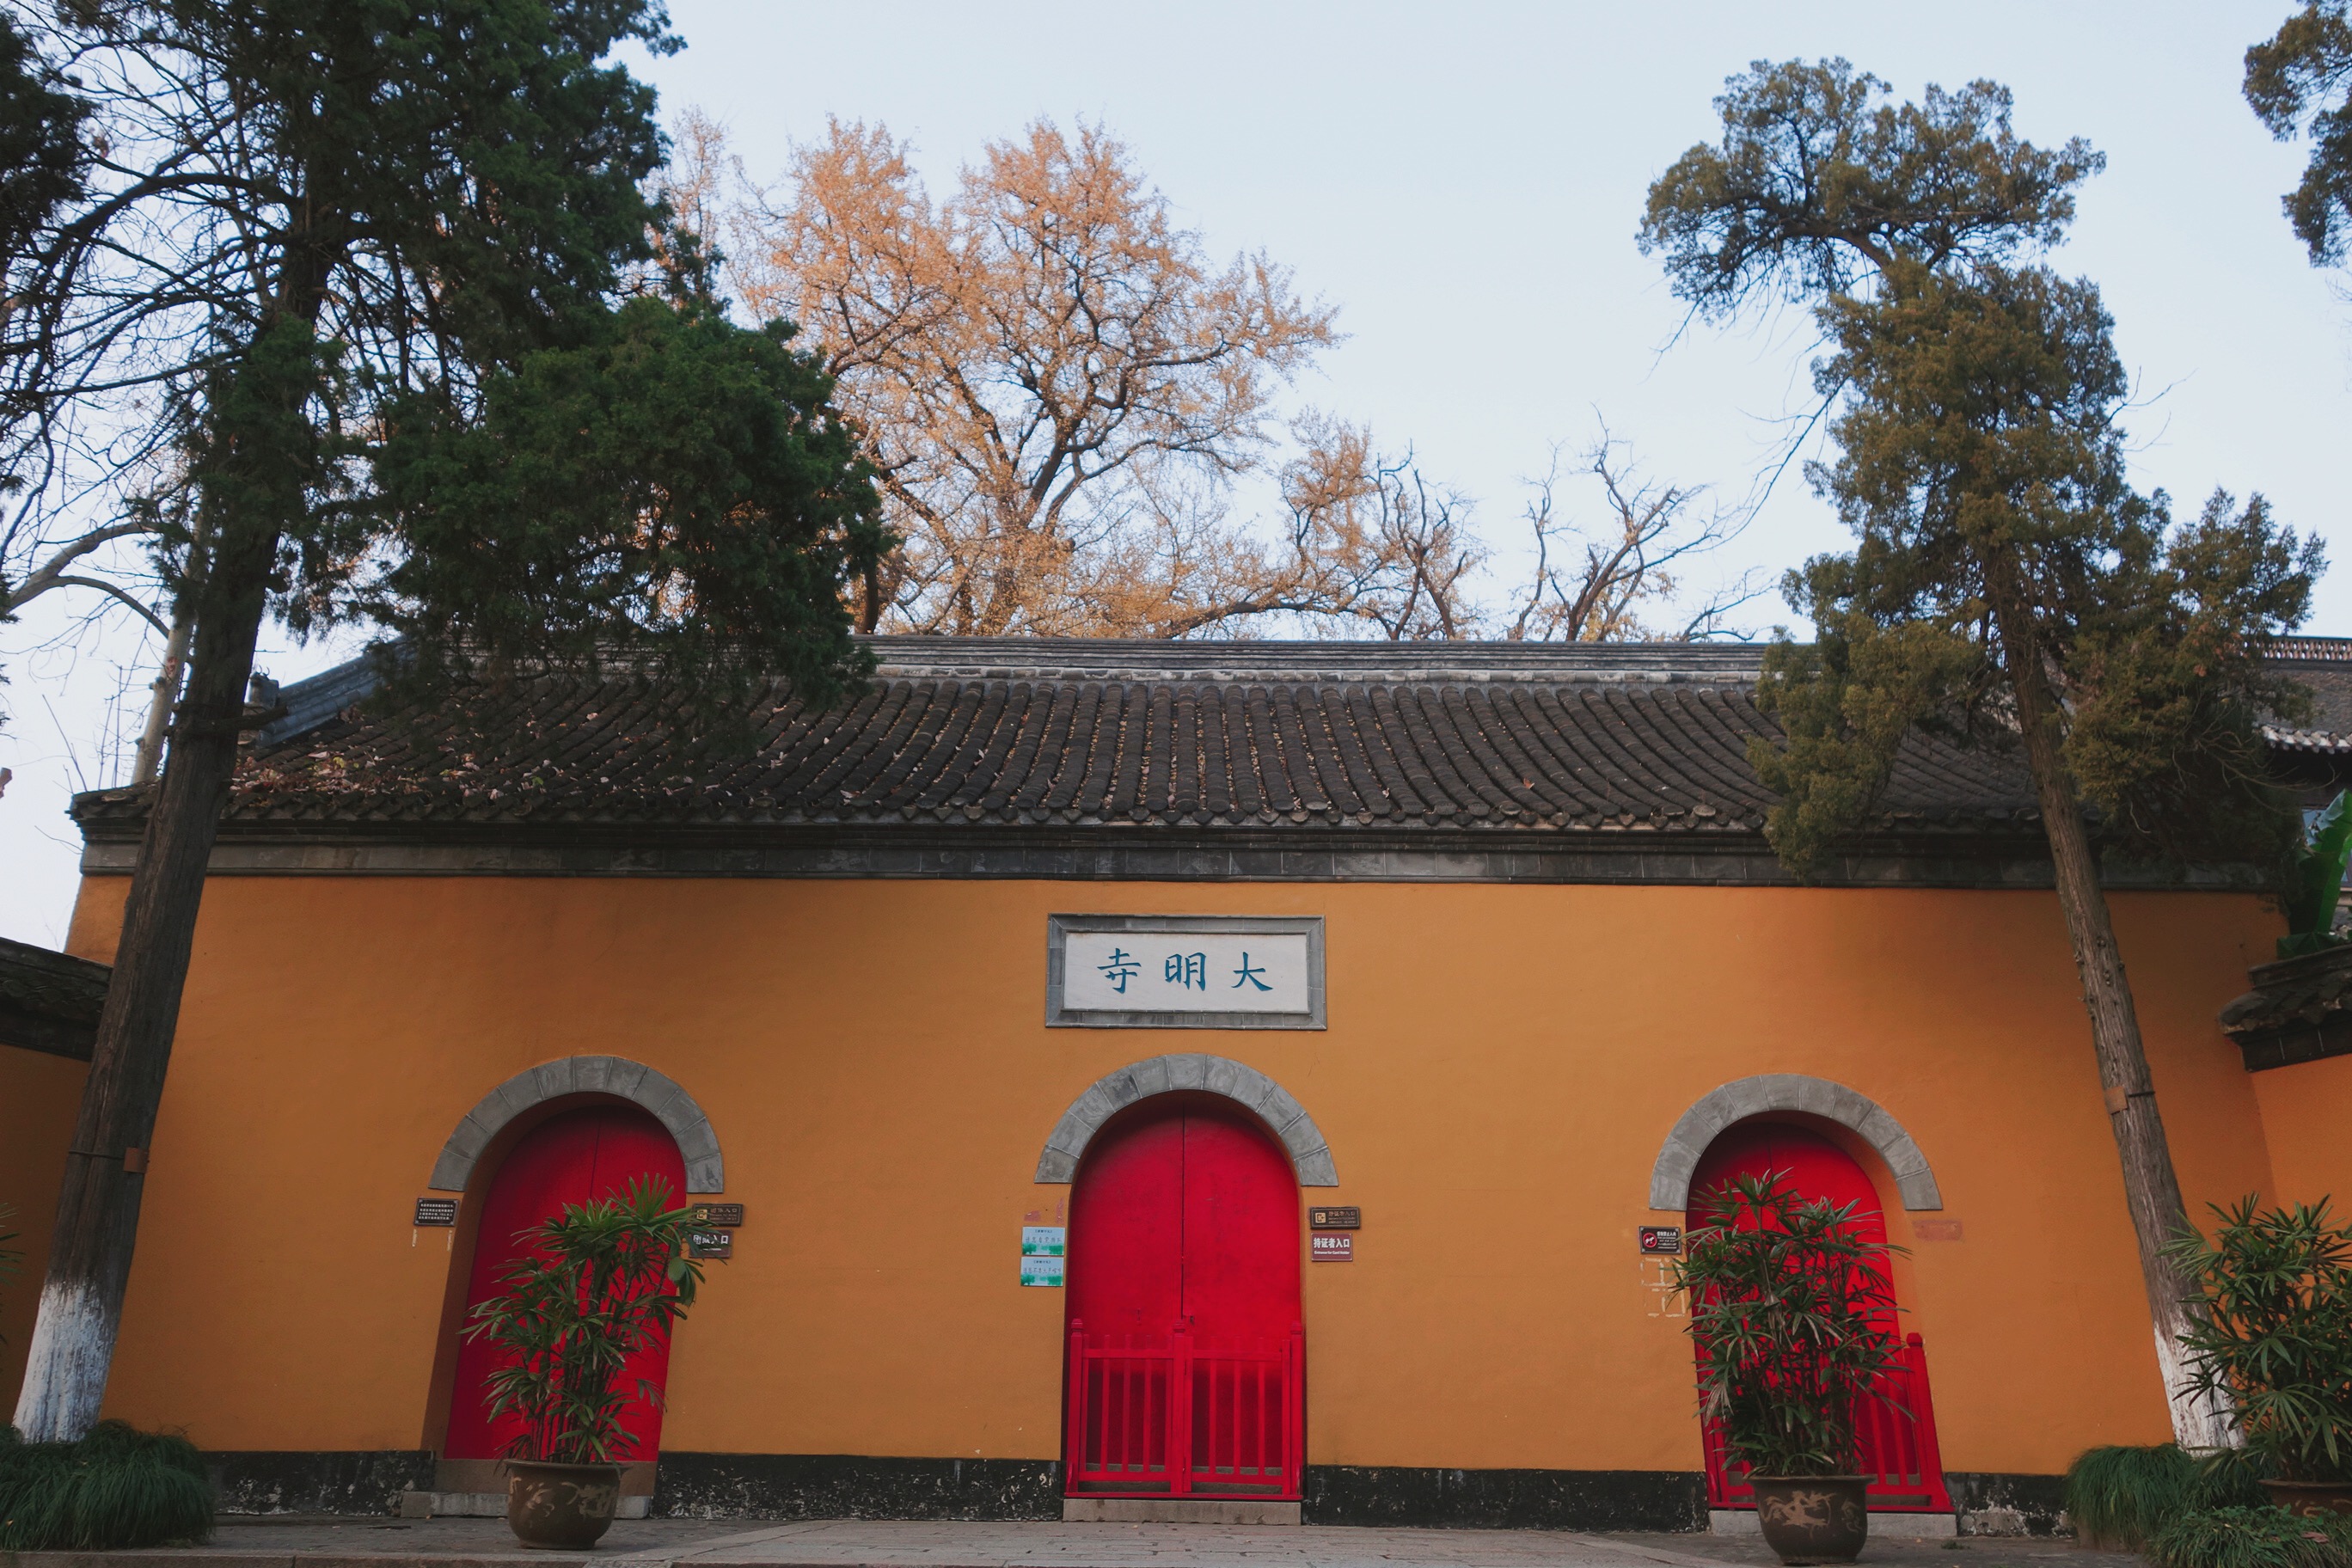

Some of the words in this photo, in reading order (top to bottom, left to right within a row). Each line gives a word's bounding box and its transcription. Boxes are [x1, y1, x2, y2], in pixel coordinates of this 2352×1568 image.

[1097, 947, 1273, 994] 大明寺
[1314, 1237, 1349, 1249] 持证者入口
